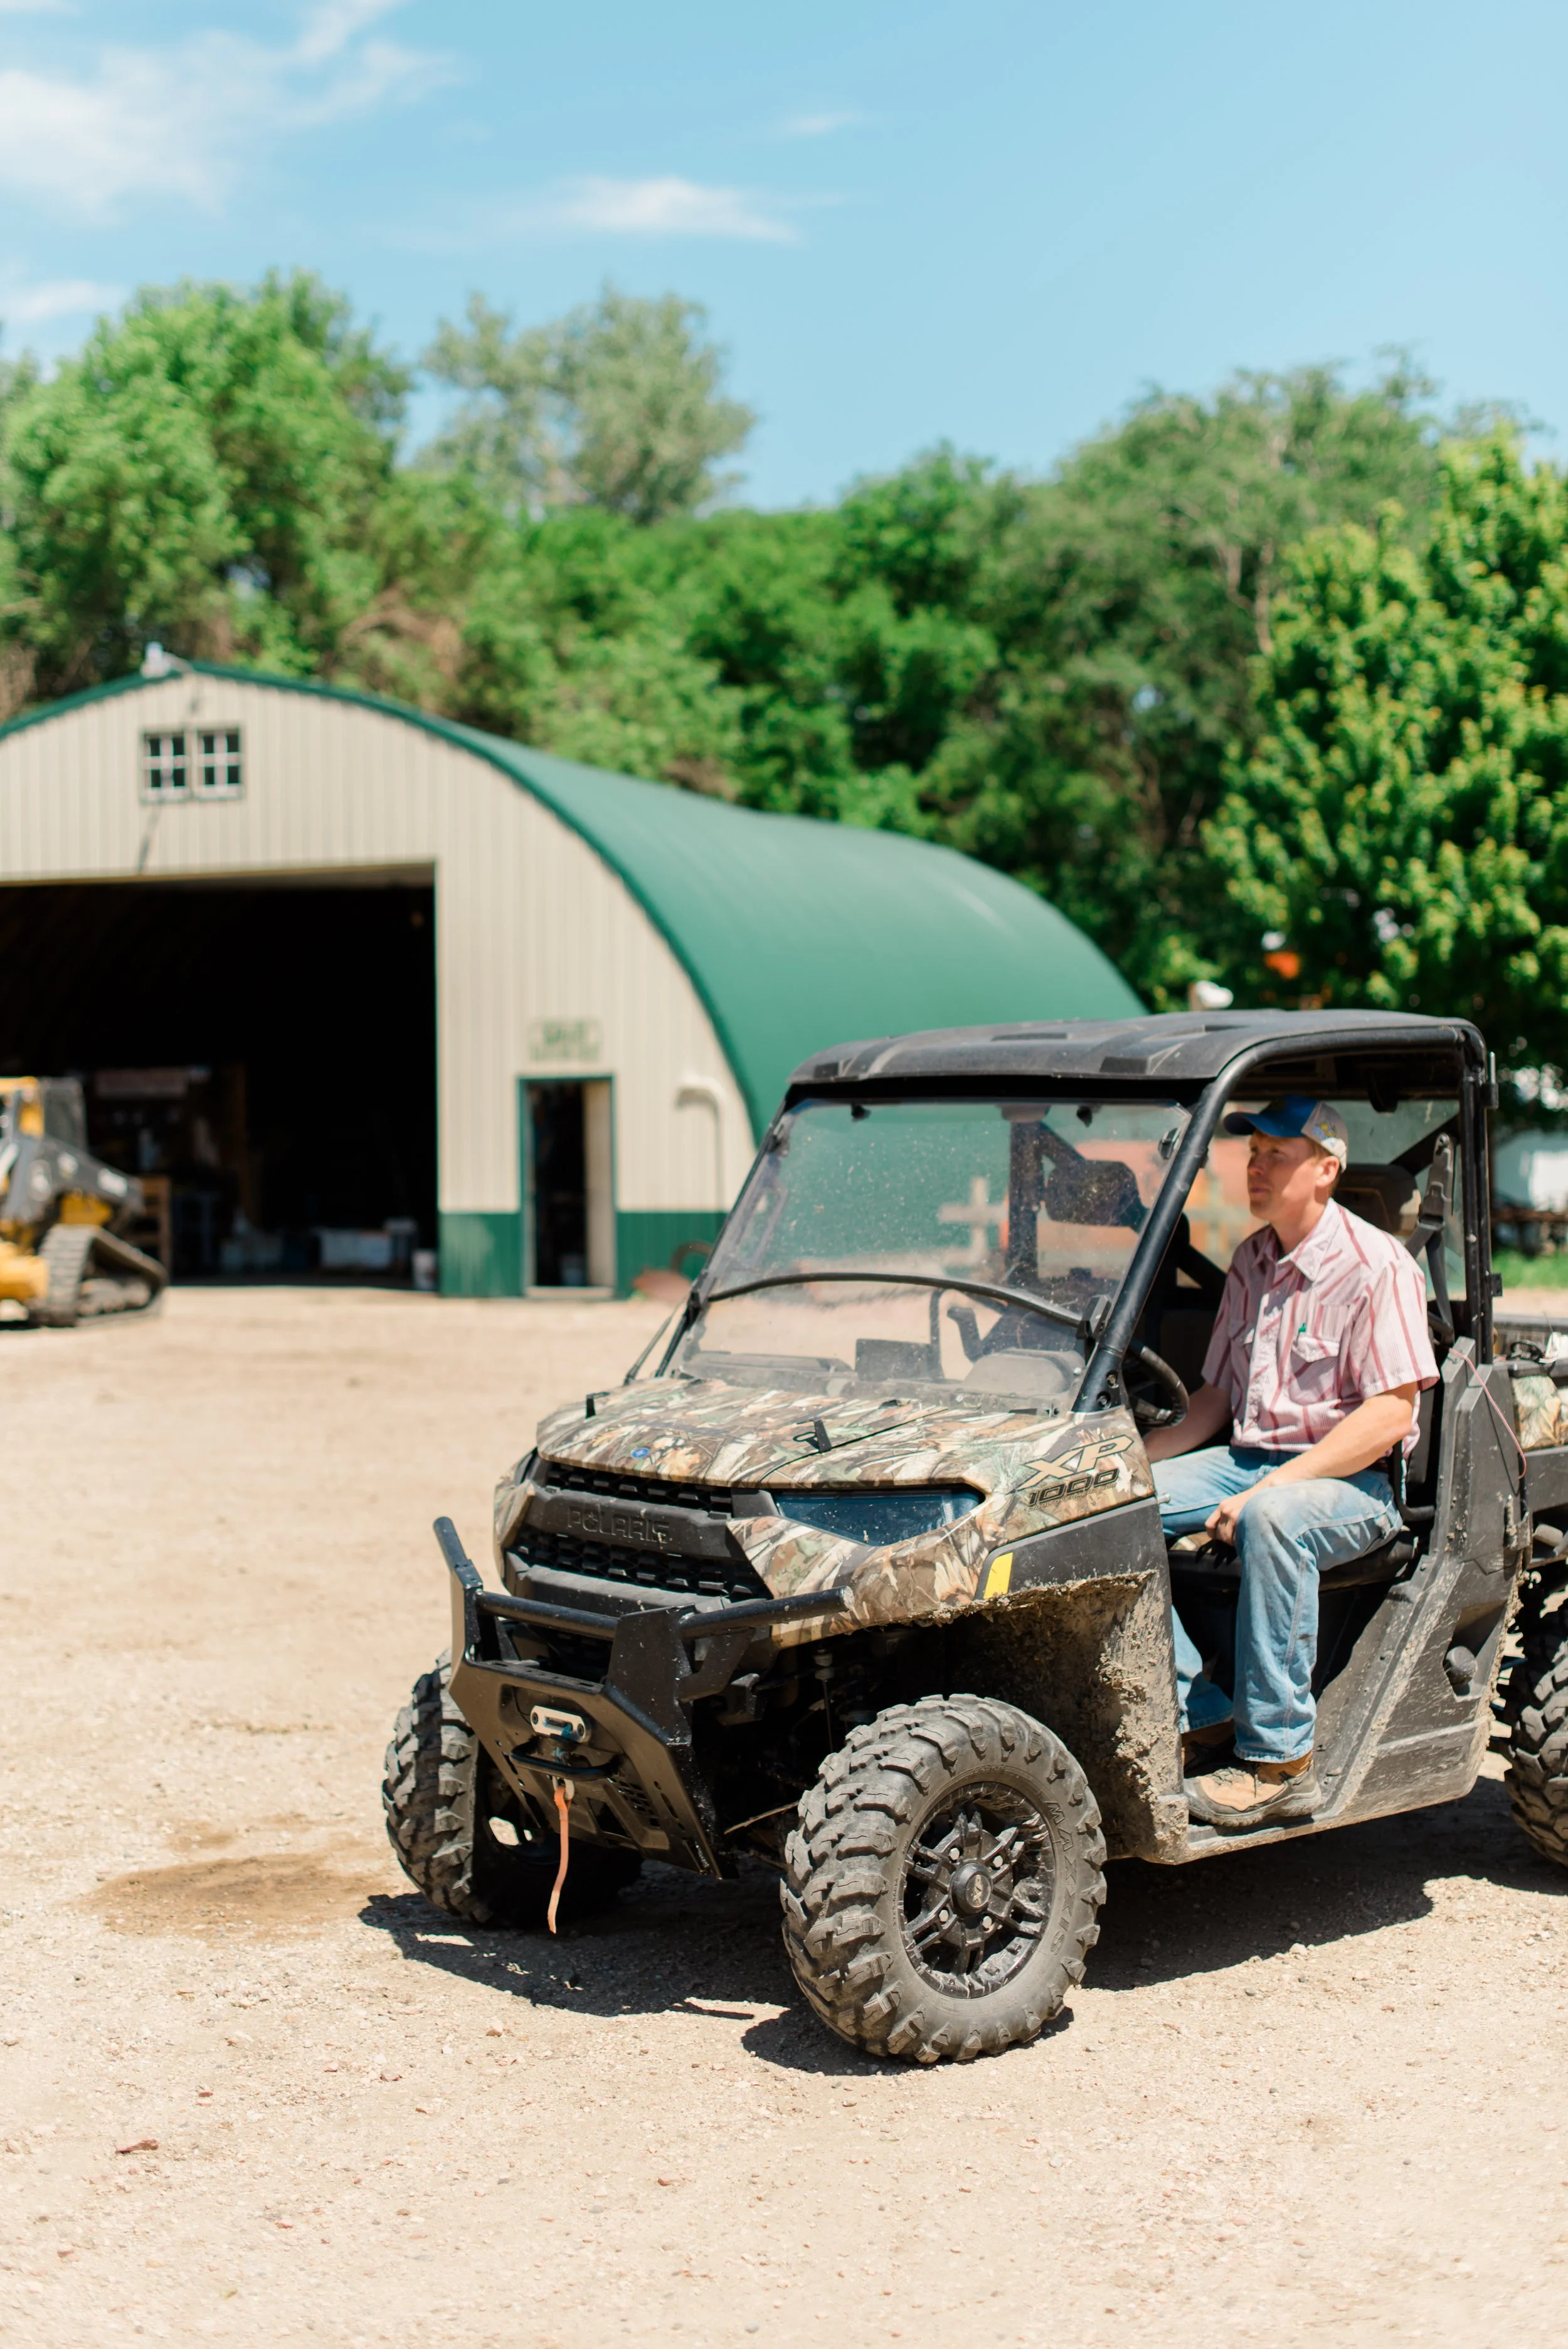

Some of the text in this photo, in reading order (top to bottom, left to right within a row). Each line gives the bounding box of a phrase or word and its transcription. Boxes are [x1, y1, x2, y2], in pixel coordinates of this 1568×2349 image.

[1016, 1434, 1134, 1491] XP
[1028, 1468, 1120, 1507] 1000
[568, 1505, 670, 1544] POLARIS
[1044, 1801, 1077, 1956] MAXXIS
